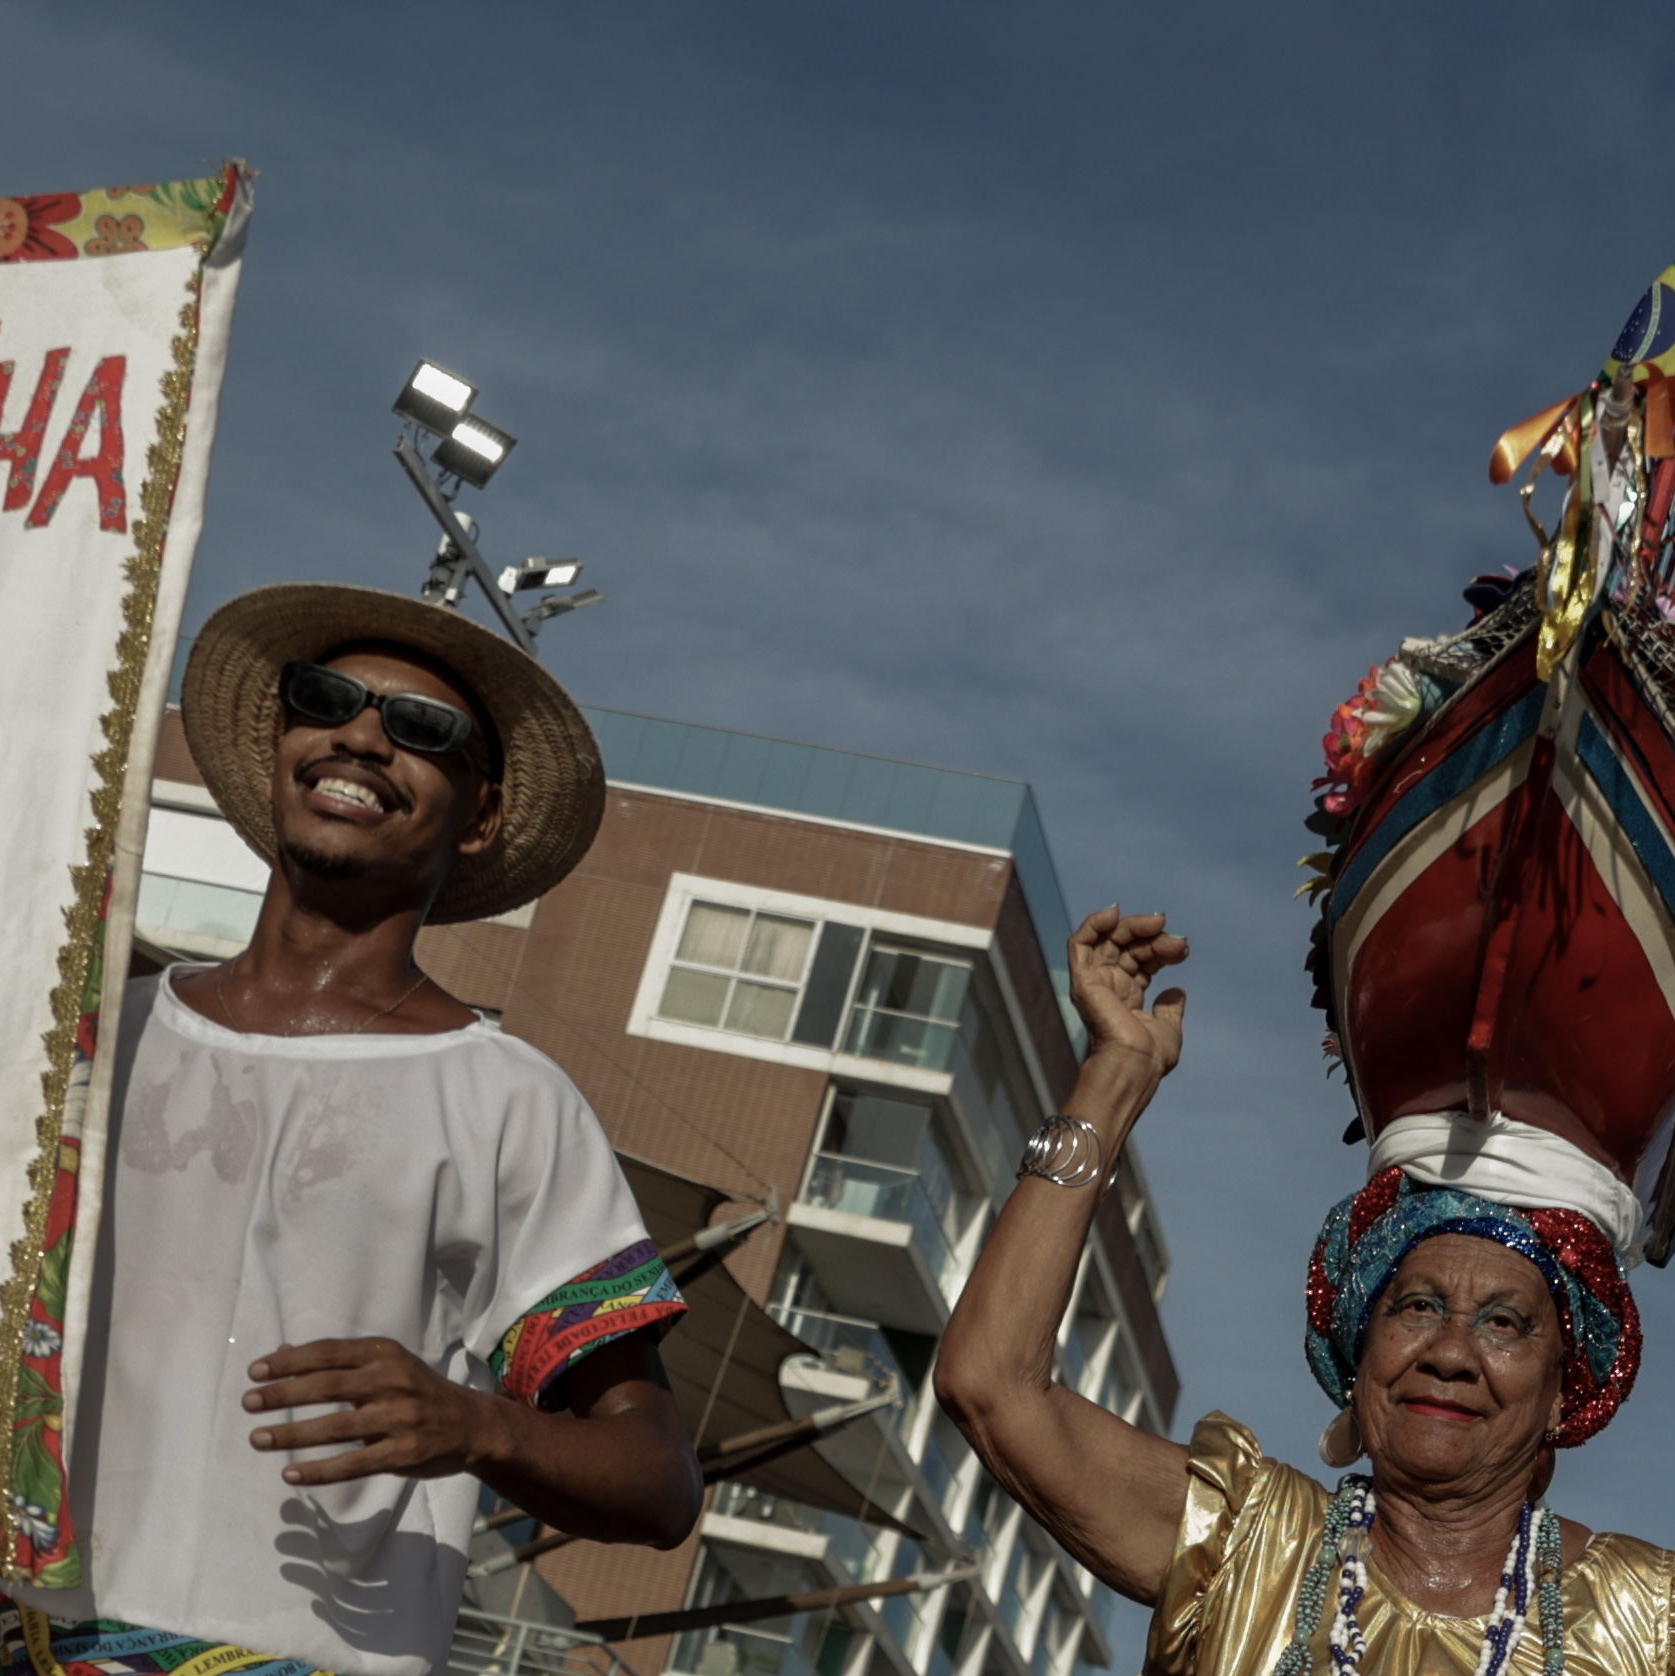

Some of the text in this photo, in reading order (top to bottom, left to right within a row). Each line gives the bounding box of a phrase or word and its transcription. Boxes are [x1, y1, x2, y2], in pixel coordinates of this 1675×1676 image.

[611, 1279, 635, 1295] DO
[552, 1304, 649, 1356] FELICIDADE
[92, 1641, 113, 1654] DO
